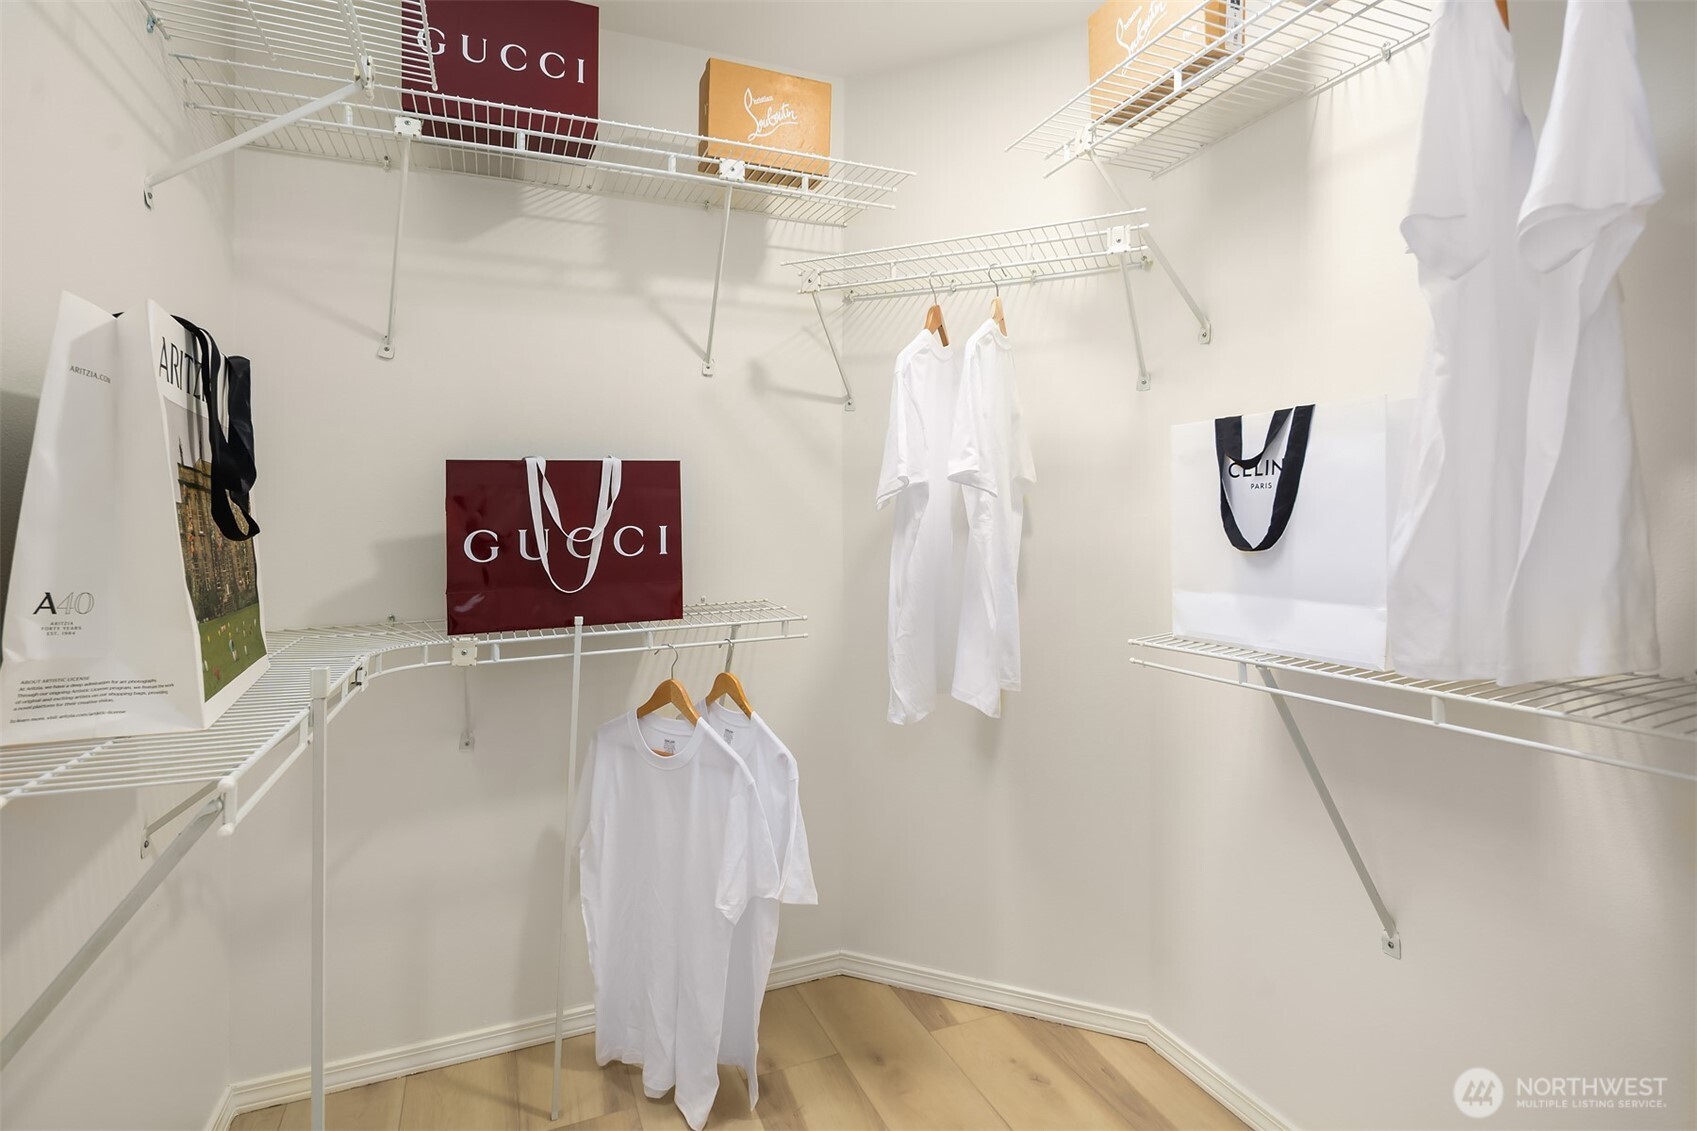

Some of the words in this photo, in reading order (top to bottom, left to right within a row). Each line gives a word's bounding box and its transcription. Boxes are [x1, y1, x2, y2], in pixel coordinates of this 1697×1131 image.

[417, 26, 585, 84] GUCCI
[159, 336, 208, 402] ARITZ
[1228, 459, 1283, 478] CELIN
[1250, 482, 1273, 490] PARIS
[463, 525, 668, 563] GUCCI
[33, 591, 95, 615] A40
